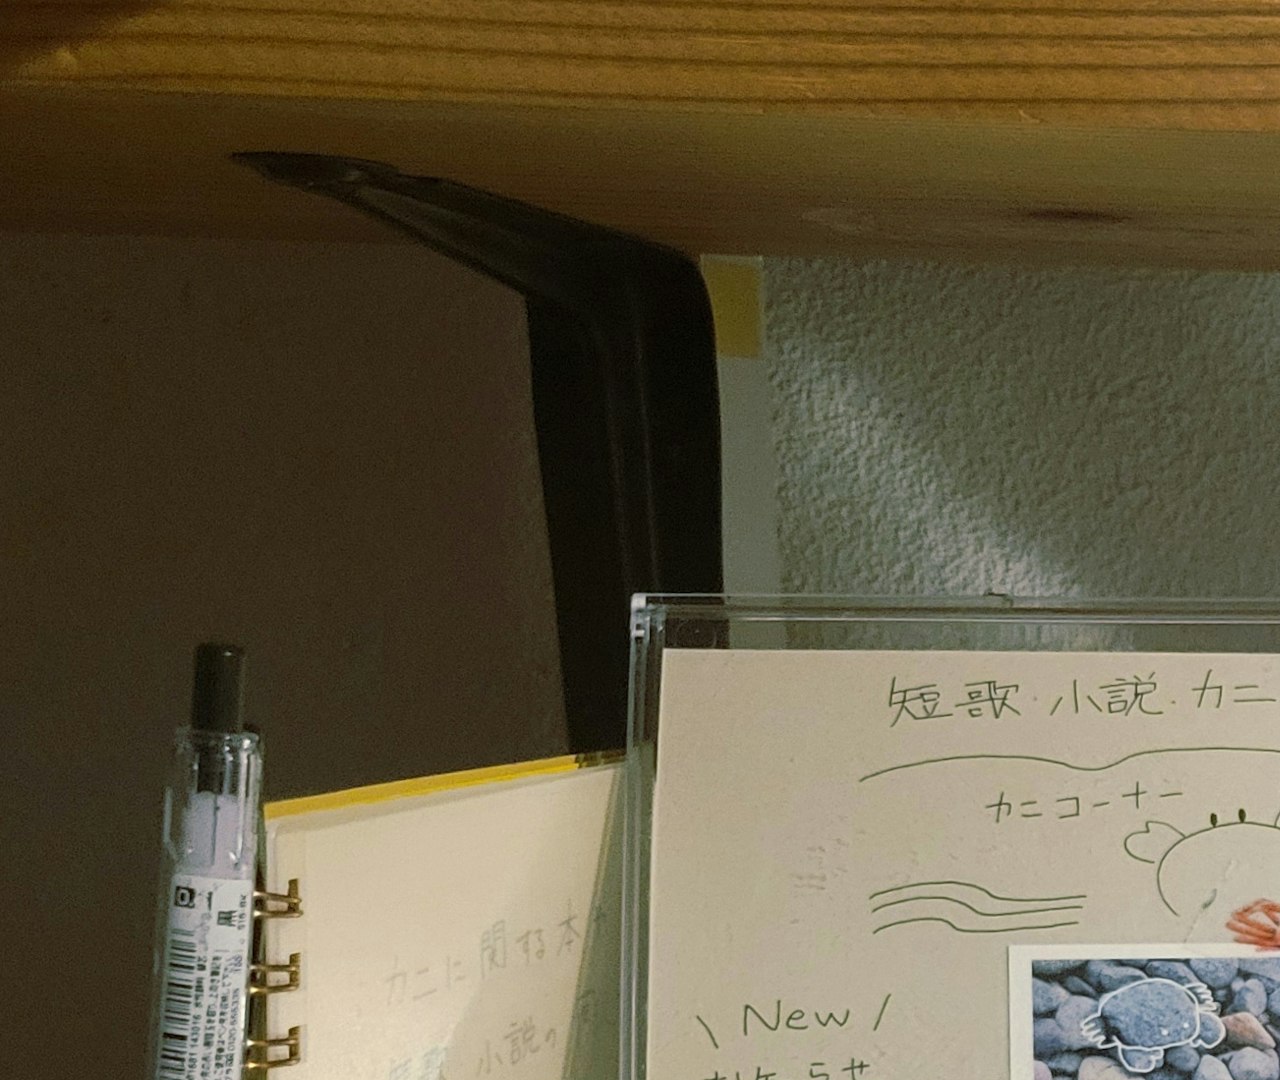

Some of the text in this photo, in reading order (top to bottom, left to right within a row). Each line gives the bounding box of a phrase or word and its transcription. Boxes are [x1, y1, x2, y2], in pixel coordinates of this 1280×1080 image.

[985, 780, 1184, 824] カニコーナー
[743, 1000, 850, 1037] New
